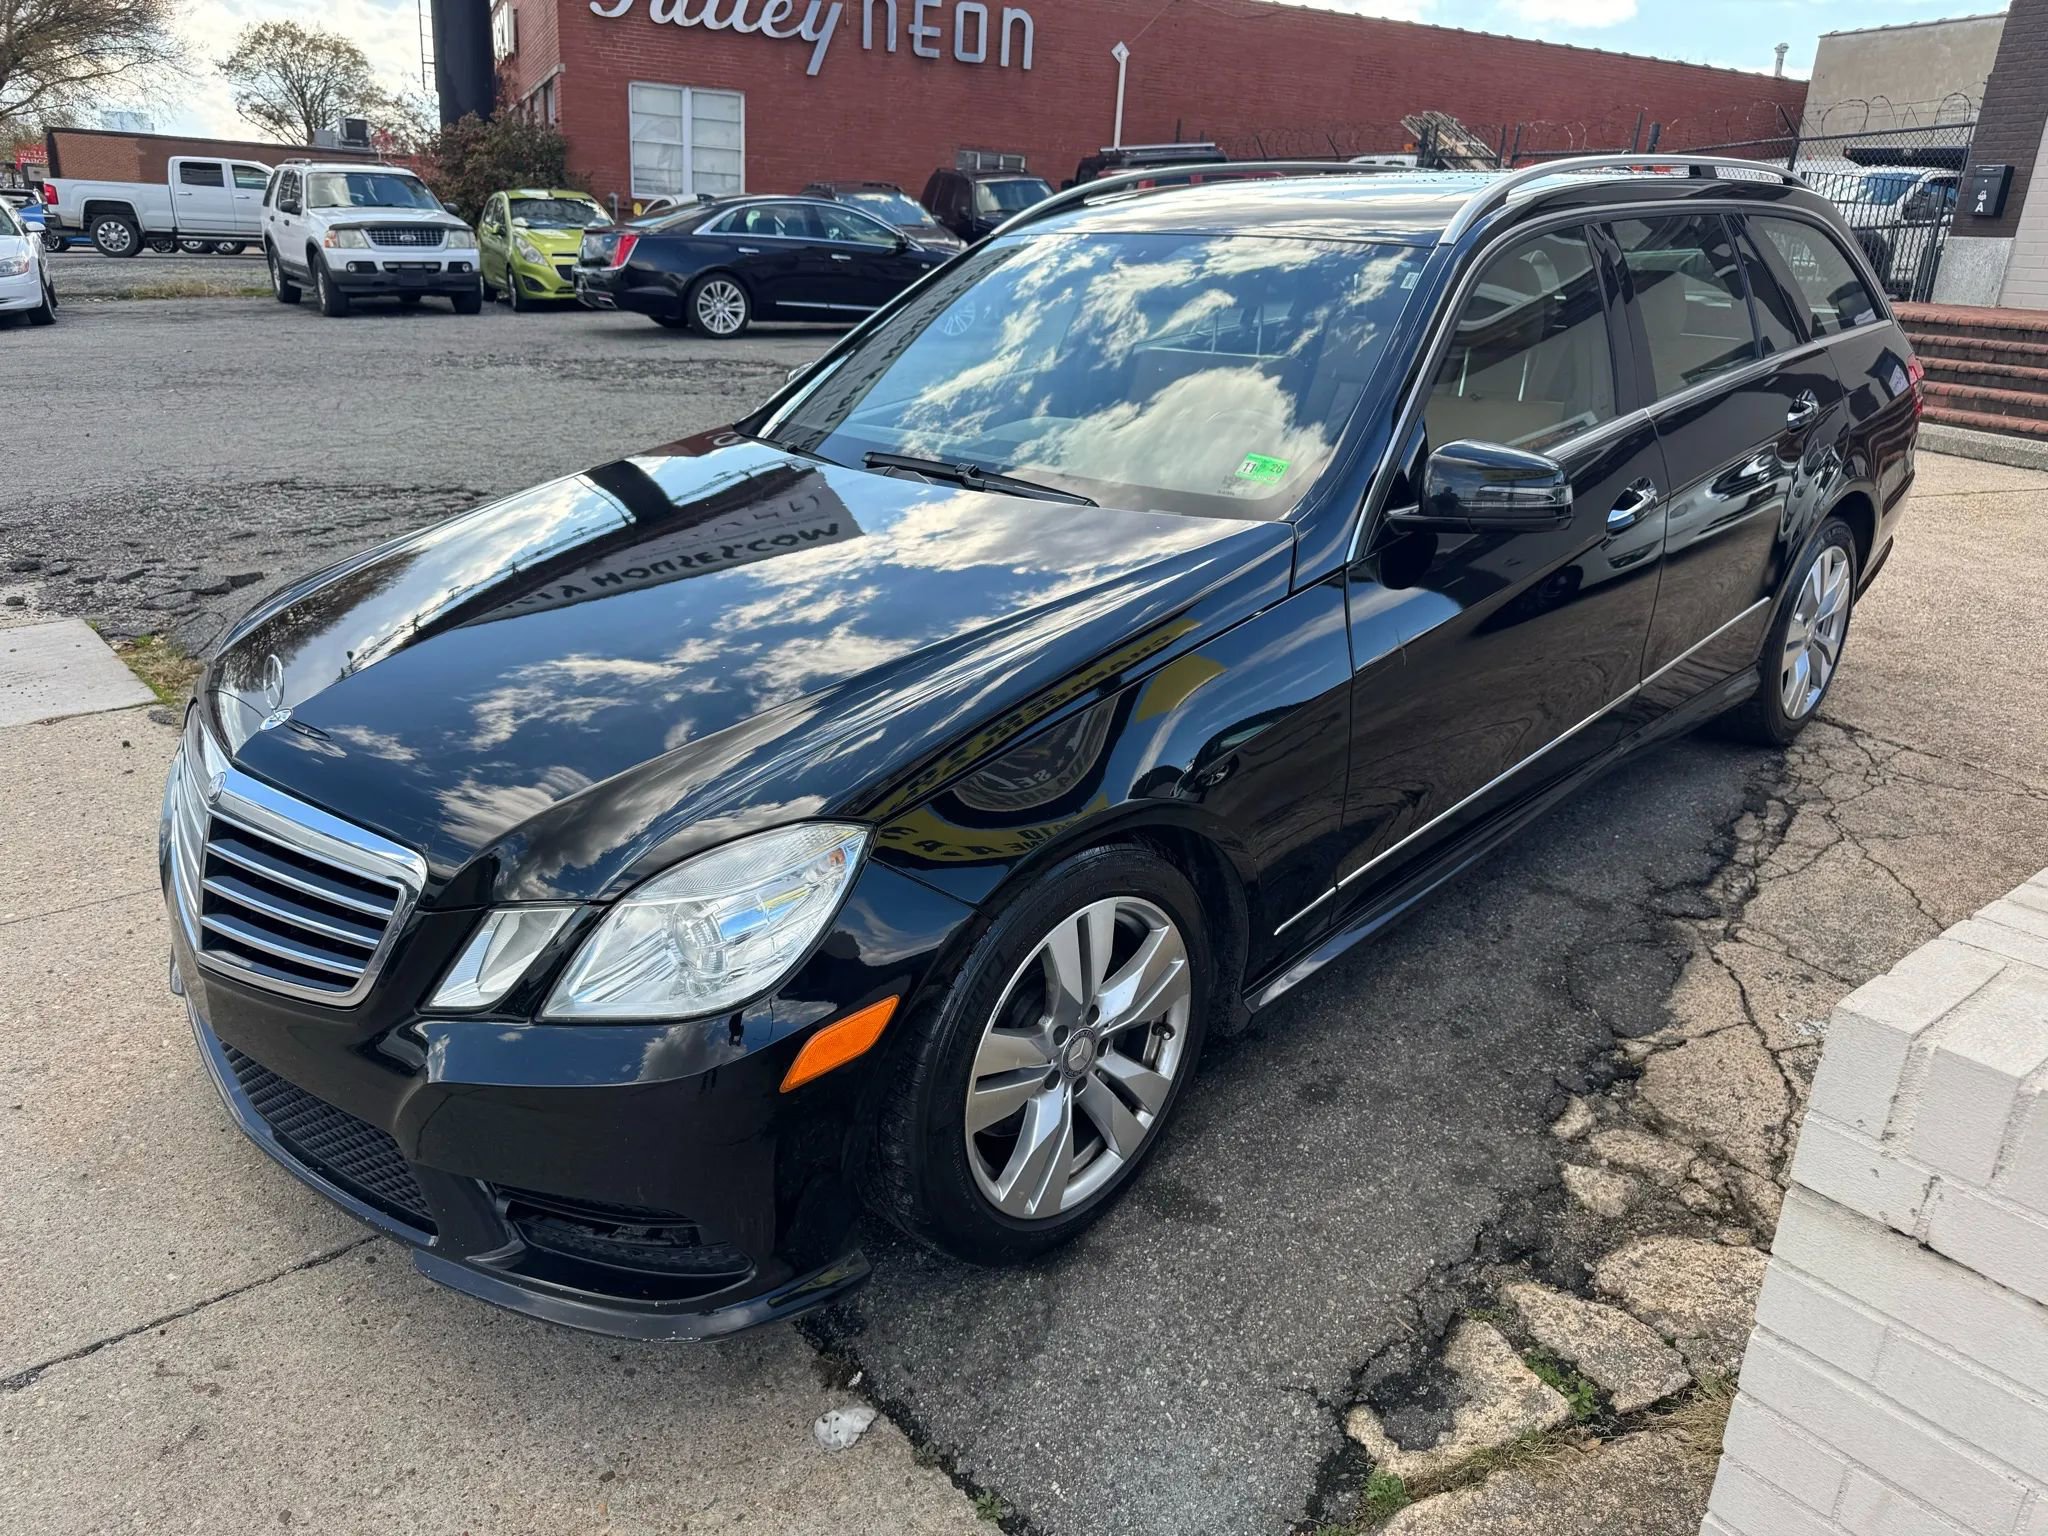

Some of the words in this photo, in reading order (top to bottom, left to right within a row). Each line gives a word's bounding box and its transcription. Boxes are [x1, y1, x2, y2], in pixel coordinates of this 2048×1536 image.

[589, 0, 843, 76] aey
[1974, 201, 1984, 213] A
[1243, 463, 1257, 473] 11
